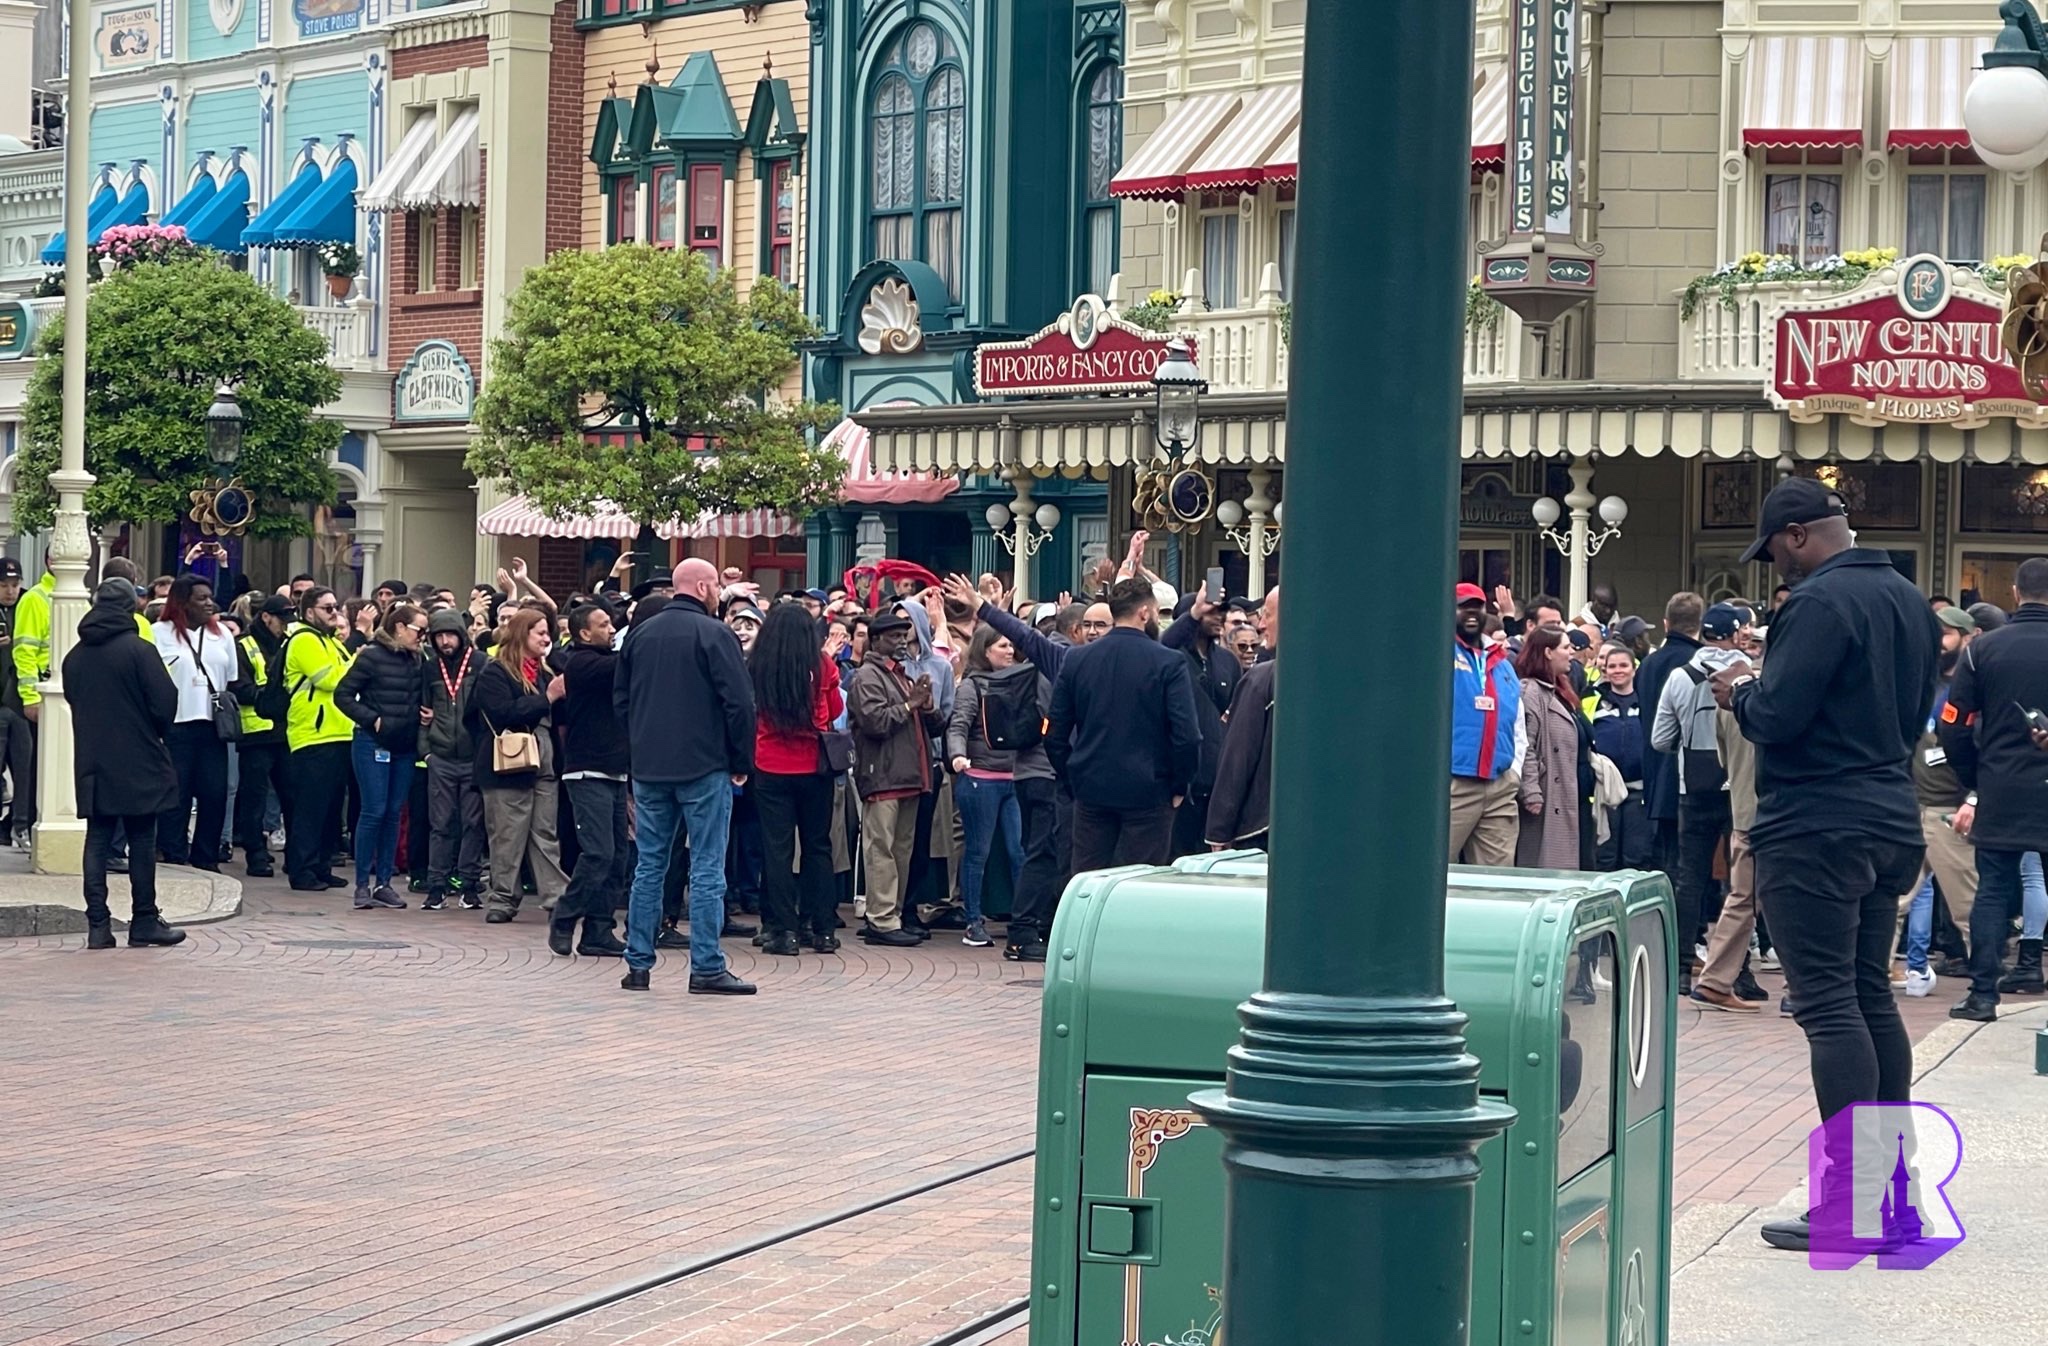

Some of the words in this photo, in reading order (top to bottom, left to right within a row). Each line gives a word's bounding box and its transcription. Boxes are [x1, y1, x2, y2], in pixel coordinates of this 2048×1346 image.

[304, 17, 329, 35] STOVE
[330, 12, 357, 30] POLISH
[1517, 0, 1535, 228] LLECTIBLES
[1550, 0, 1569, 206] OUVENIRS
[422, 351, 452, 372] DISNEY
[985, 354, 1055, 383] IMPORTS
[1056, 356, 1068, 377] &
[1071, 350, 1128, 379] FANCY
[1128, 347, 1170, 376] GOO
[1782, 317, 1872, 387] NEW
[1879, 317, 2015, 368] CENTU
[409, 374, 464, 408] CLOTHIERS
[1852, 358, 1988, 391] NOTIONS
[1810, 397, 1860, 412] Unique
[1879, 397, 1962, 420] FLORA'S
[1976, 402, 2034, 417] Boutique
